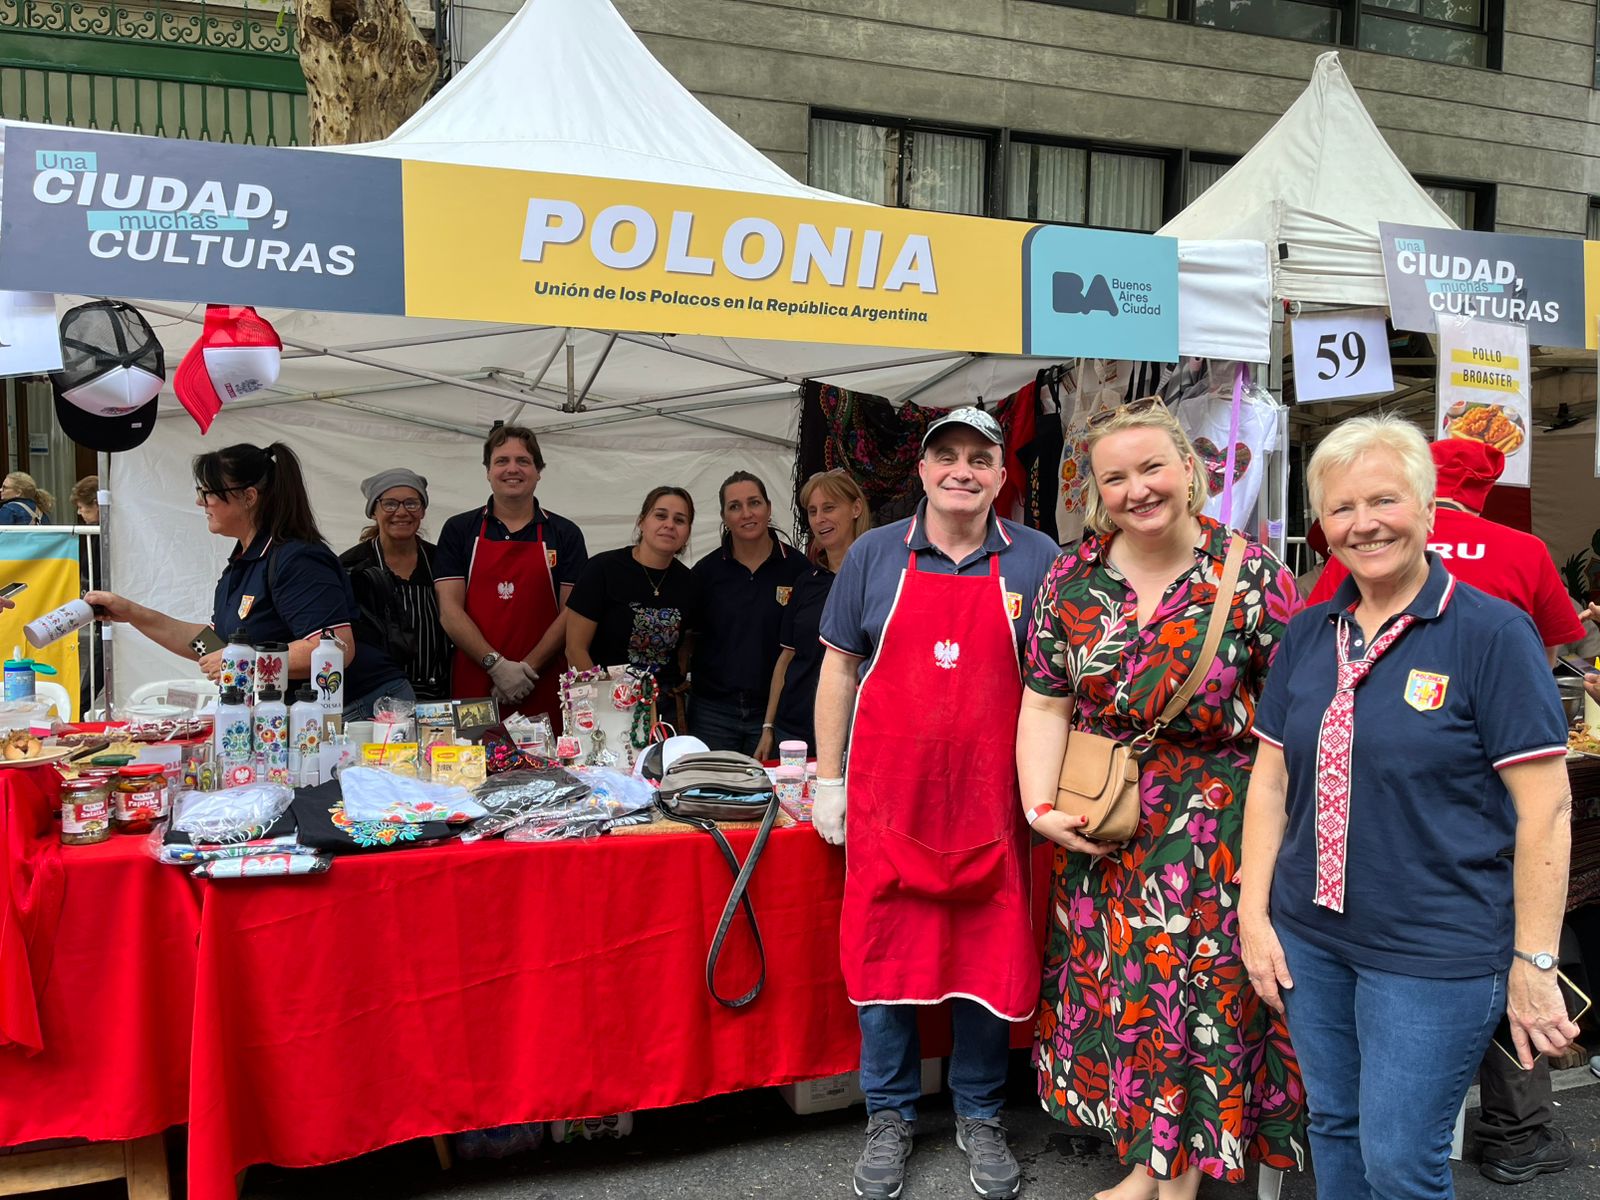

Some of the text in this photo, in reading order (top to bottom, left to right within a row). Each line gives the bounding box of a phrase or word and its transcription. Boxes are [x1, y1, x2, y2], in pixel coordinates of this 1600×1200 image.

[42, 152, 87, 170] Una
[32, 167, 289, 230] CIUDAD,
[119, 211, 219, 230] muchas
[88, 229, 356, 276] CULTURAS
[519, 197, 938, 294] POLONIA
[1397, 239, 1420, 251] Una
[1396, 250, 1525, 291] CIUDAD,
[1112, 278, 1152, 292] Buenos
[1440, 279, 1489, 293] muchas
[534, 280, 928, 323] Unión de los Polacos en la República Argentina
[1118, 290, 1149, 303] Aires
[1122, 302, 1161, 316] Ciudad
[1429, 291, 1560, 323] CULTURAS
[1316, 330, 1367, 381] 59
[1472, 346, 1502, 363] POLLO
[1463, 368, 1513, 388] BROASTER
